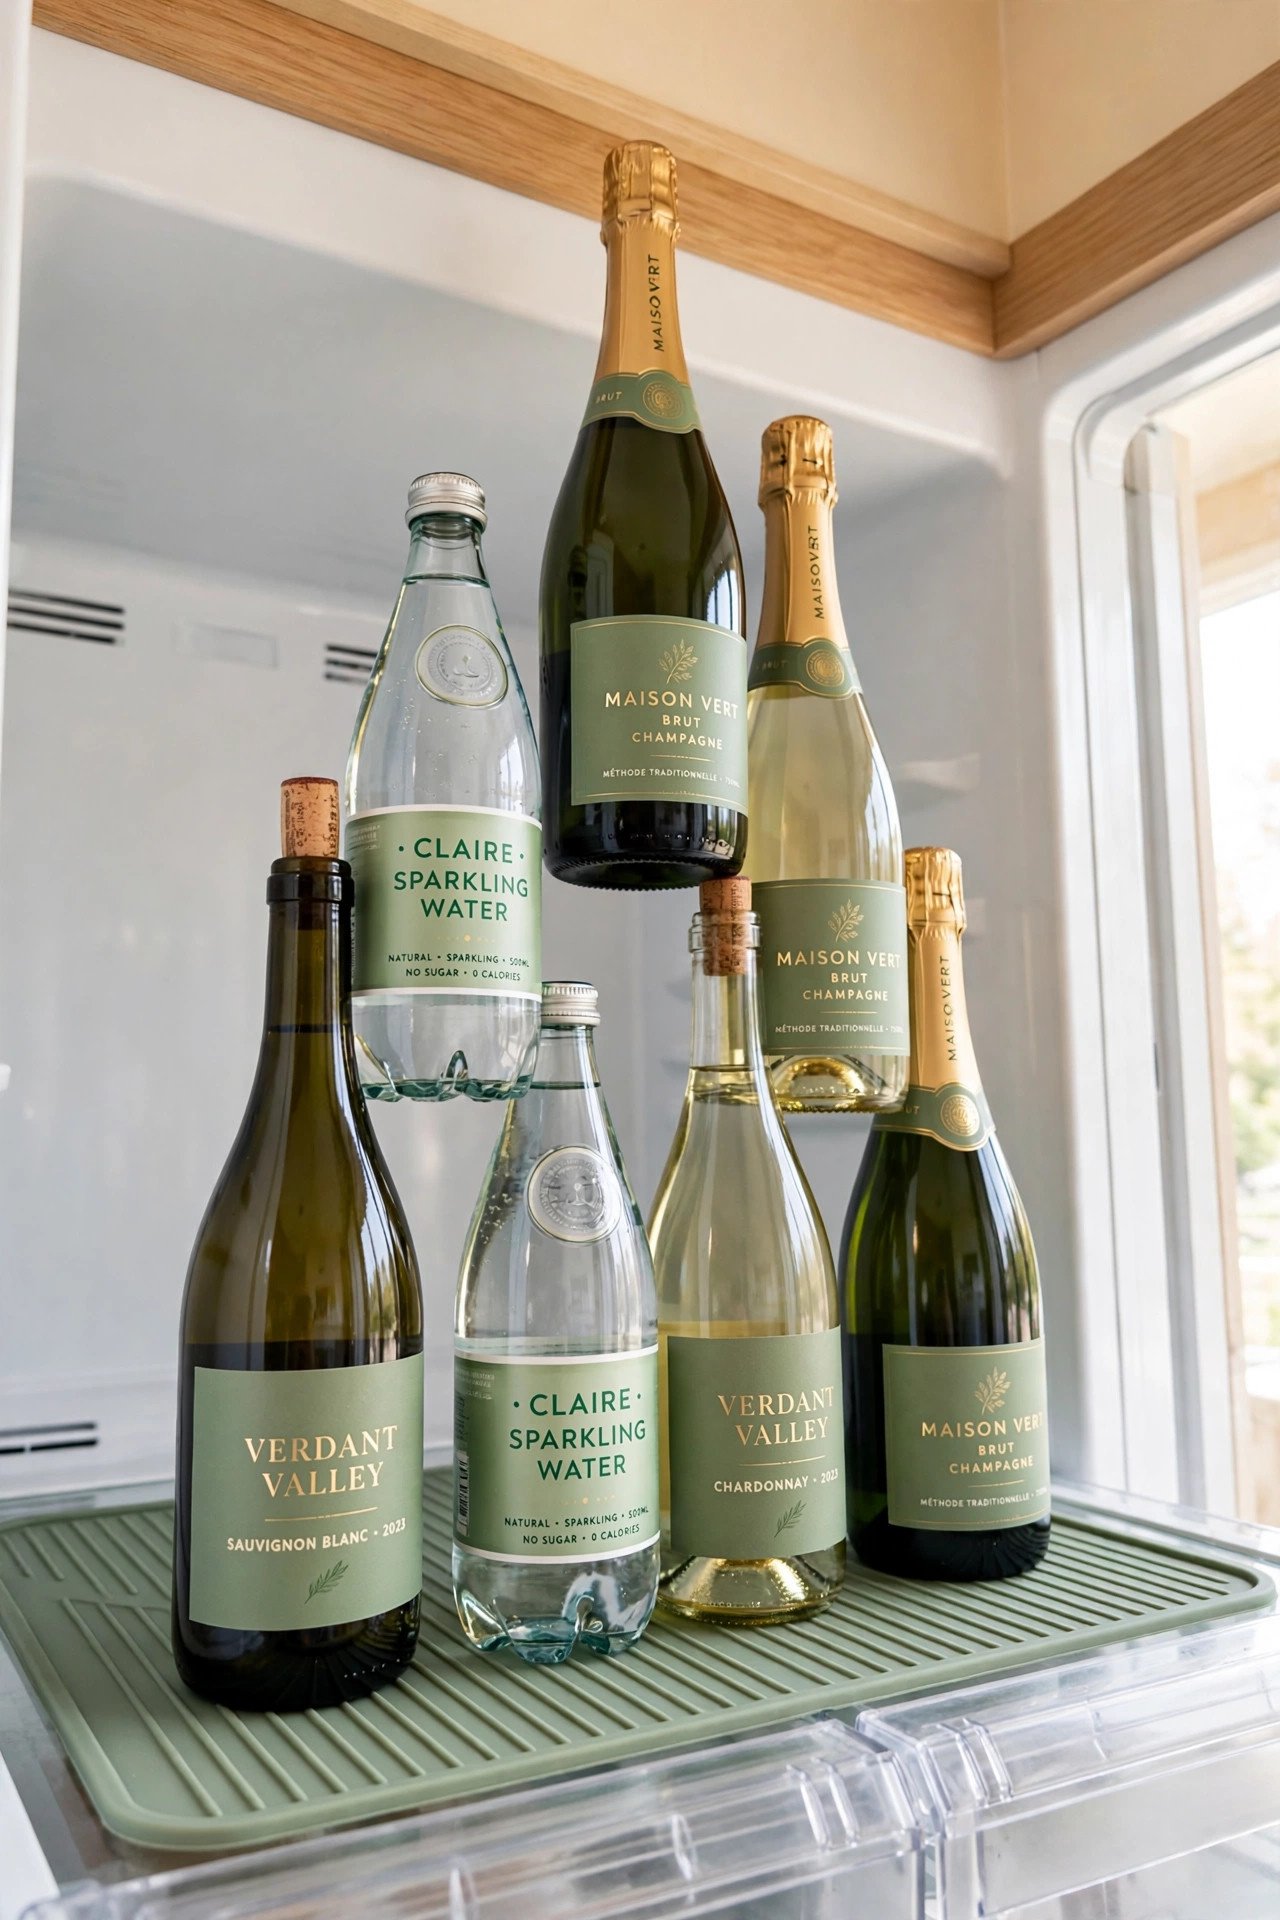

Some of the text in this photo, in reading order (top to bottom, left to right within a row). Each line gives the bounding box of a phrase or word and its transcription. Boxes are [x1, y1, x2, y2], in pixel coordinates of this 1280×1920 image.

[605, 690, 738, 719] MAISON VERT
[662, 714, 701, 728] BRUT
[631, 731, 723, 750] CHAMPAGNE
[602, 767, 646, 778] MÉTHODE
[650, 768, 717, 782] TRADITIONNELLE
[414, 837, 513, 863] CLAIRE
[394, 870, 528, 897] SPARKLING
[420, 898, 507, 921] WATER
[388, 953, 432, 963] NATURAL
[446, 953, 499, 963] SPARKLING
[777, 950, 901, 968] MAISON VERT
[405, 968, 421, 977] NO
[424, 968, 459, 977] SUGAR
[481, 970, 520, 981] CALORIES
[831, 972, 868, 983] BRUT
[802, 989, 889, 1001] CHAMPAGNE
[820, 1024, 883, 1033] TRADITIONNELLE
[529, 1388, 631, 1417] CLAIRE
[717, 1386, 834, 1417] VERDANT
[509, 1420, 646, 1450] SPARKLING
[735, 1416, 828, 1446] VALLEY
[921, 1420, 1007, 1438] MAISON
[245, 1425, 398, 1463] VERDANT
[978, 1442, 1015, 1456] BRUT
[537, 1454, 626, 1481] WATER
[949, 1455, 1034, 1474] CHAMPAGNE
[262, 1461, 384, 1498] VALLEY
[713, 1468, 838, 1493] CHARDONNAY 2023
[920, 1497, 964, 1507] MÉTHODE
[966, 1492, 1031, 1507] TRADITIONNELLE
[504, 1517, 550, 1527] NATURAL
[564, 1513, 618, 1527] SPARKLING
[227, 1517, 406, 1552] SAUVIGNON BLANC 2023
[522, 1535, 538, 1544] NO
[542, 1535, 577, 1544] SUGAR
[600, 1524, 640, 1540] CALORIES
